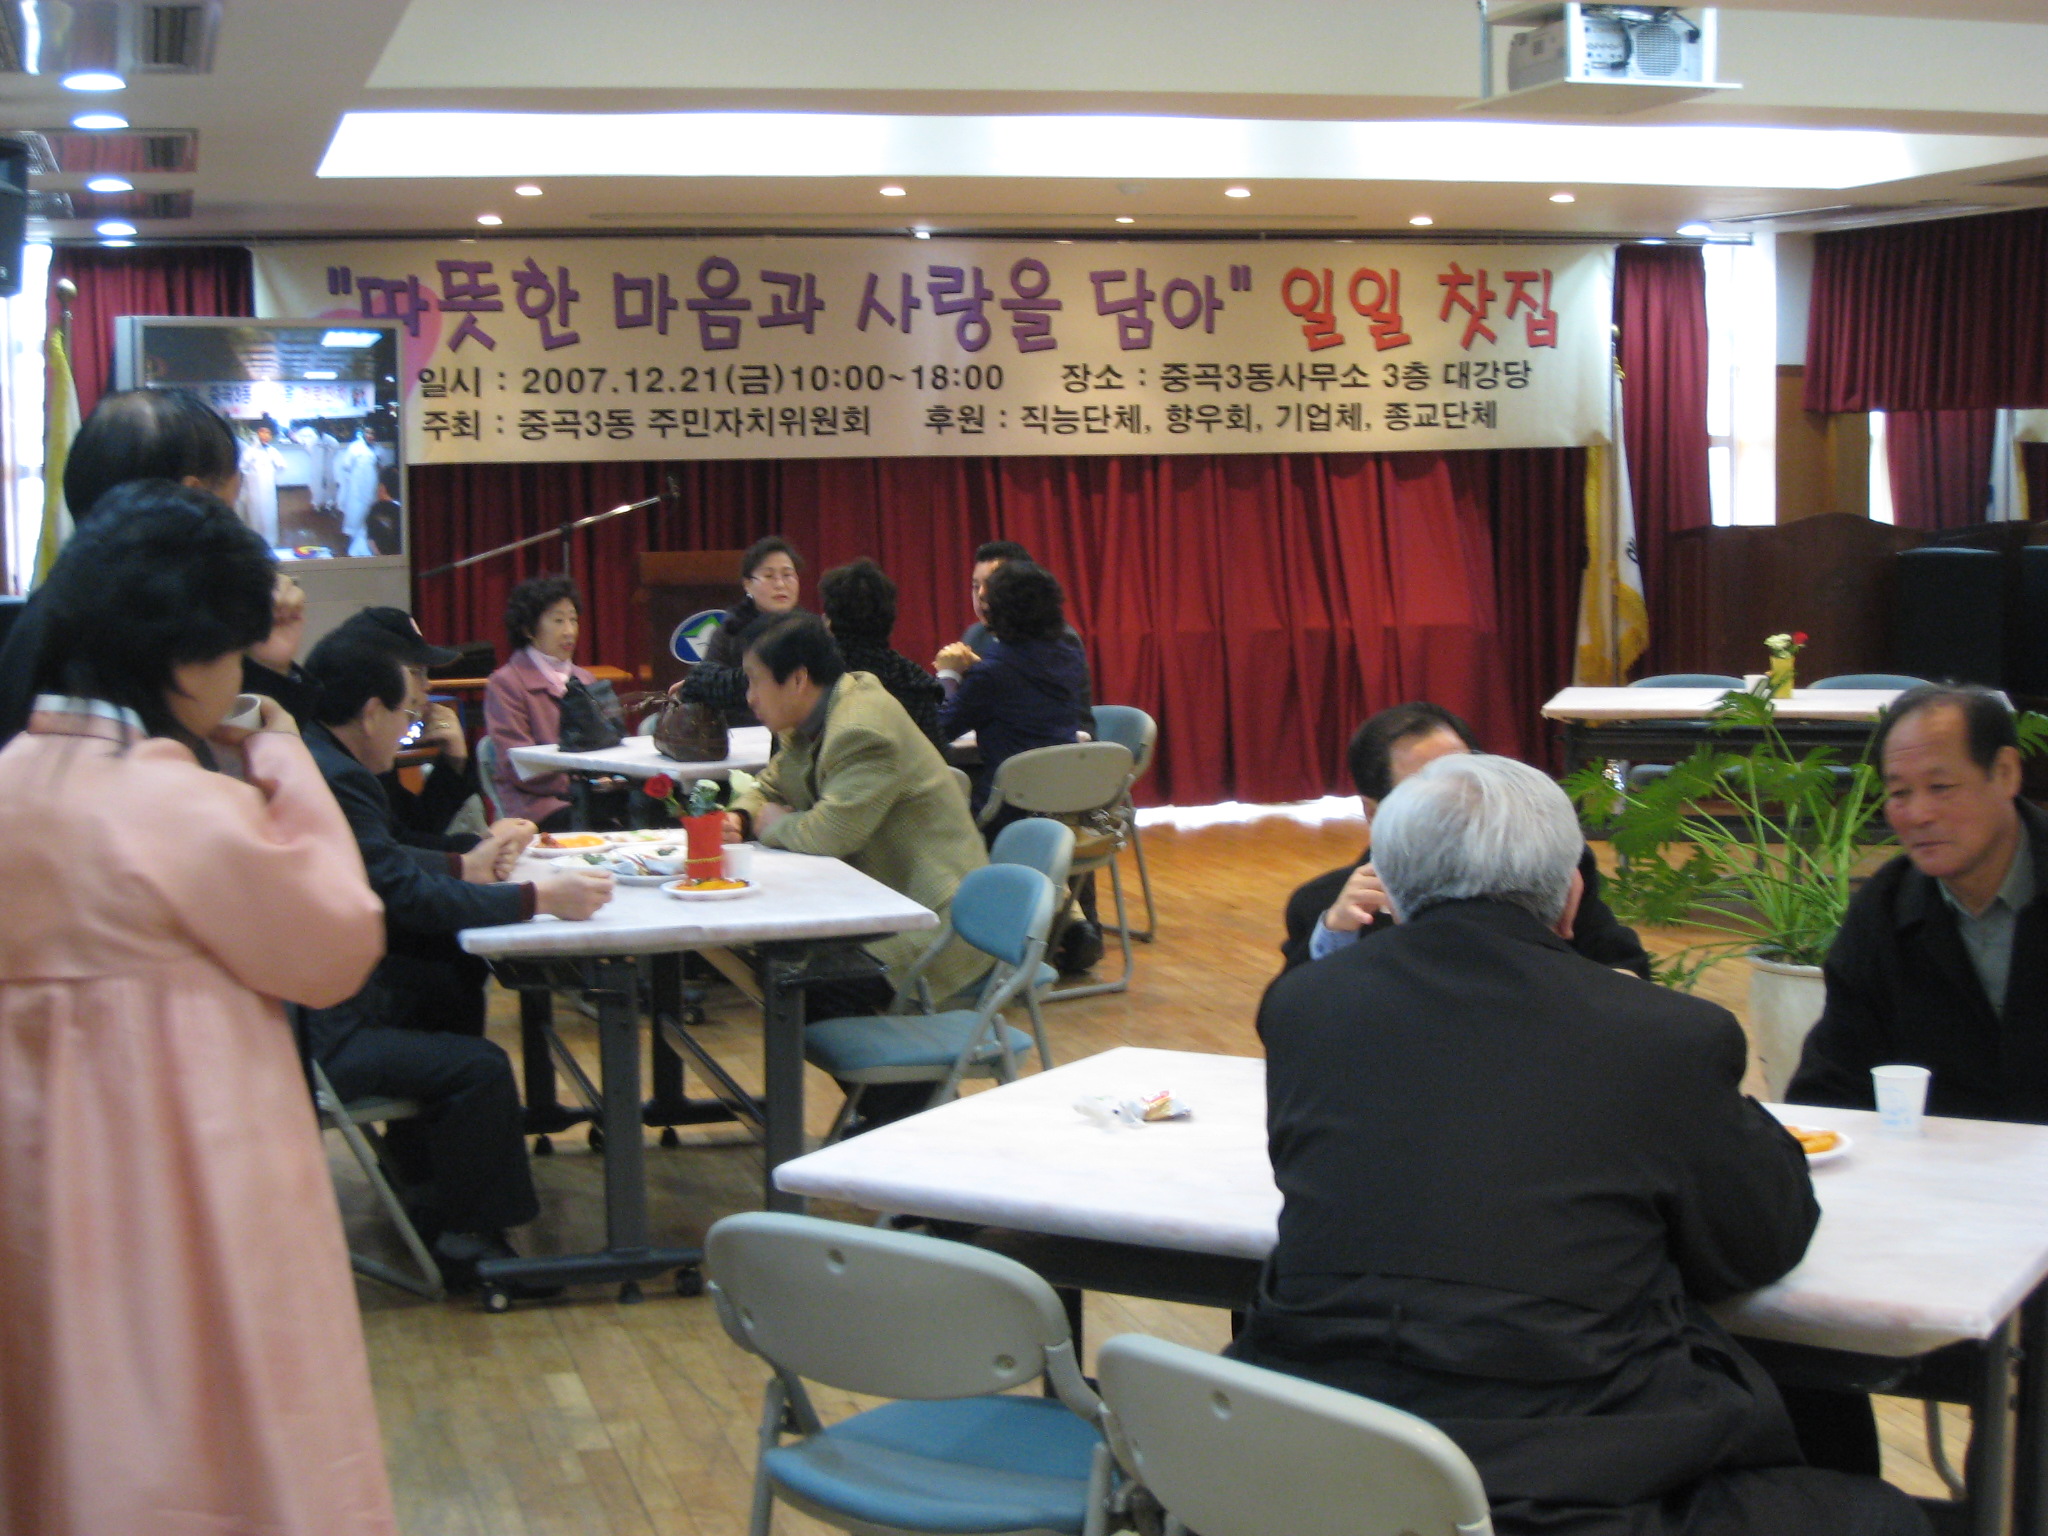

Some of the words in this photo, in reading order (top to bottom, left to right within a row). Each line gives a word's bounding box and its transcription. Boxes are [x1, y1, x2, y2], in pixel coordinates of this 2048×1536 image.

[613, 255, 826, 351] 마음과
[857, 256, 1062, 353] 사랑을
[1089, 264, 1252, 351] 담아"
[1281, 266, 1413, 352] 일일
[1437, 261, 1559, 351] 찻집
[417, 366, 482, 399] 일시
[1061, 363, 1125, 394] 장소
[1160, 361, 1371, 393] 중곡3동사무소
[1382, 361, 1432, 391] 3층
[1443, 360, 1533, 391] 대강당
[422, 409, 481, 441] 주최
[517, 408, 636, 441] 중곡3동
[647, 405, 871, 440] 주민자치위원회
[924, 404, 985, 436] 후원
[1020, 404, 1152, 436] 직능단체,
[1165, 402, 1263, 434] 향우회,
[1275, 401, 1373, 433] 기업체,
[1383, 400, 1498, 432] 종교단체
